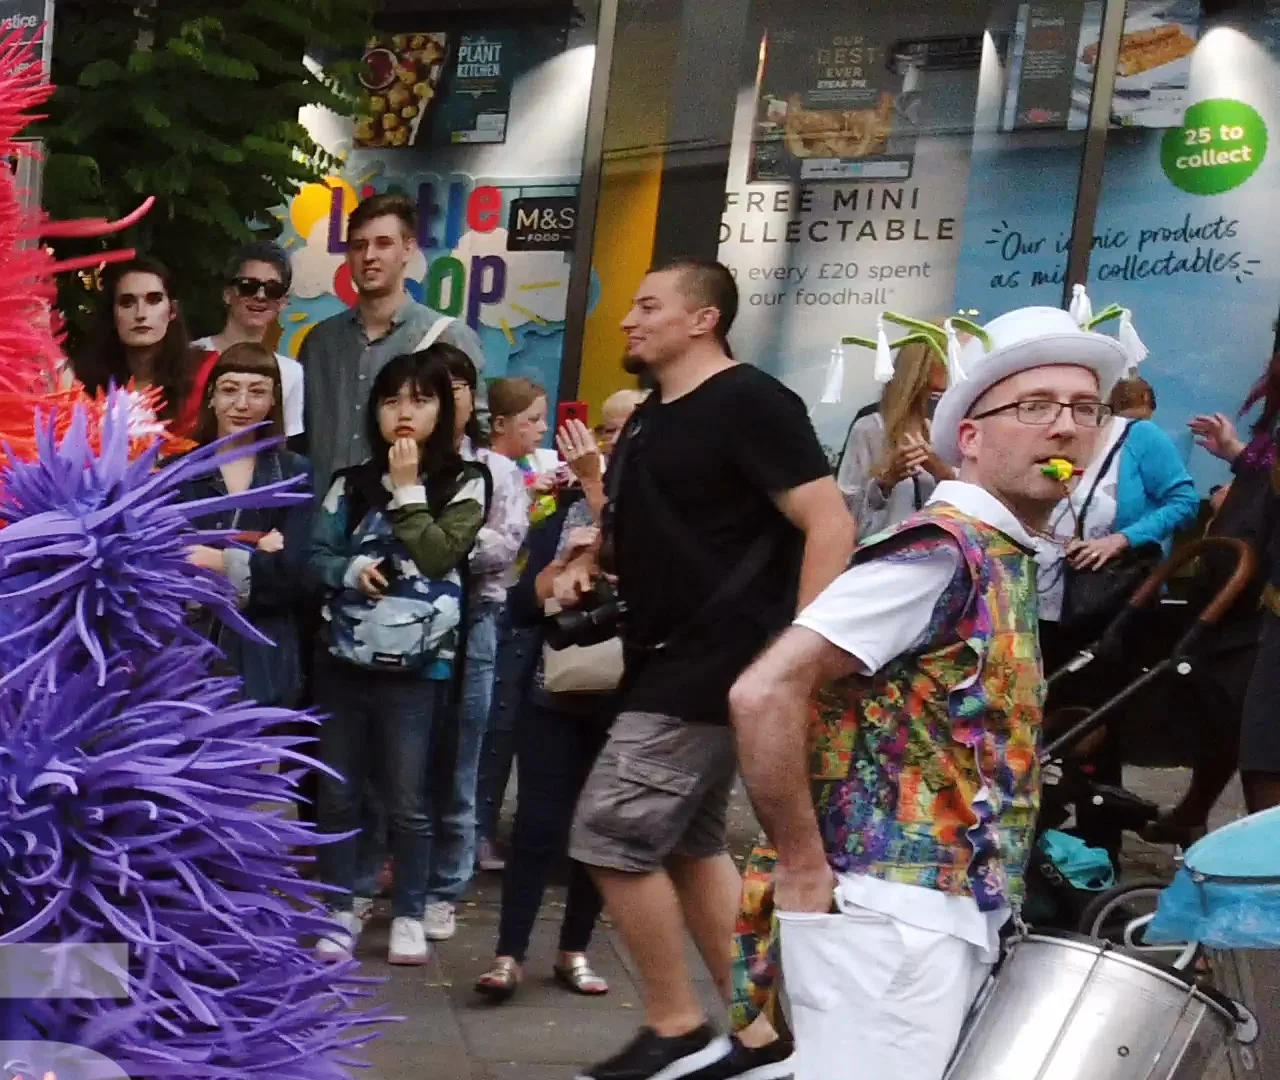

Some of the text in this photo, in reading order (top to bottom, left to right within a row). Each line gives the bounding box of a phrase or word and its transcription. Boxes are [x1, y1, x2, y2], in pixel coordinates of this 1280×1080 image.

[458, 44, 502, 63] PLANT
[456, 63, 501, 77] KITCHEN
[826, 66, 862, 78] EVER
[1183, 124, 1244, 146] 25 to
[1175, 145, 1252, 169] collect
[725, 188, 920, 213] FREE MINI
[327, 181, 503, 253] Ltle
[515, 207, 575, 231] M&S
[527, 234, 560, 242] FOOD
[718, 218, 956, 243] OLLECTABLE
[1001, 231, 1047, 261] Our
[1138, 213, 1240, 252] products
[748, 265, 809, 284] every
[818, 262, 859, 279] £20
[867, 261, 932, 284] spent
[990, 246, 1242, 289] as mi collectables
[748, 293, 790, 306] our
